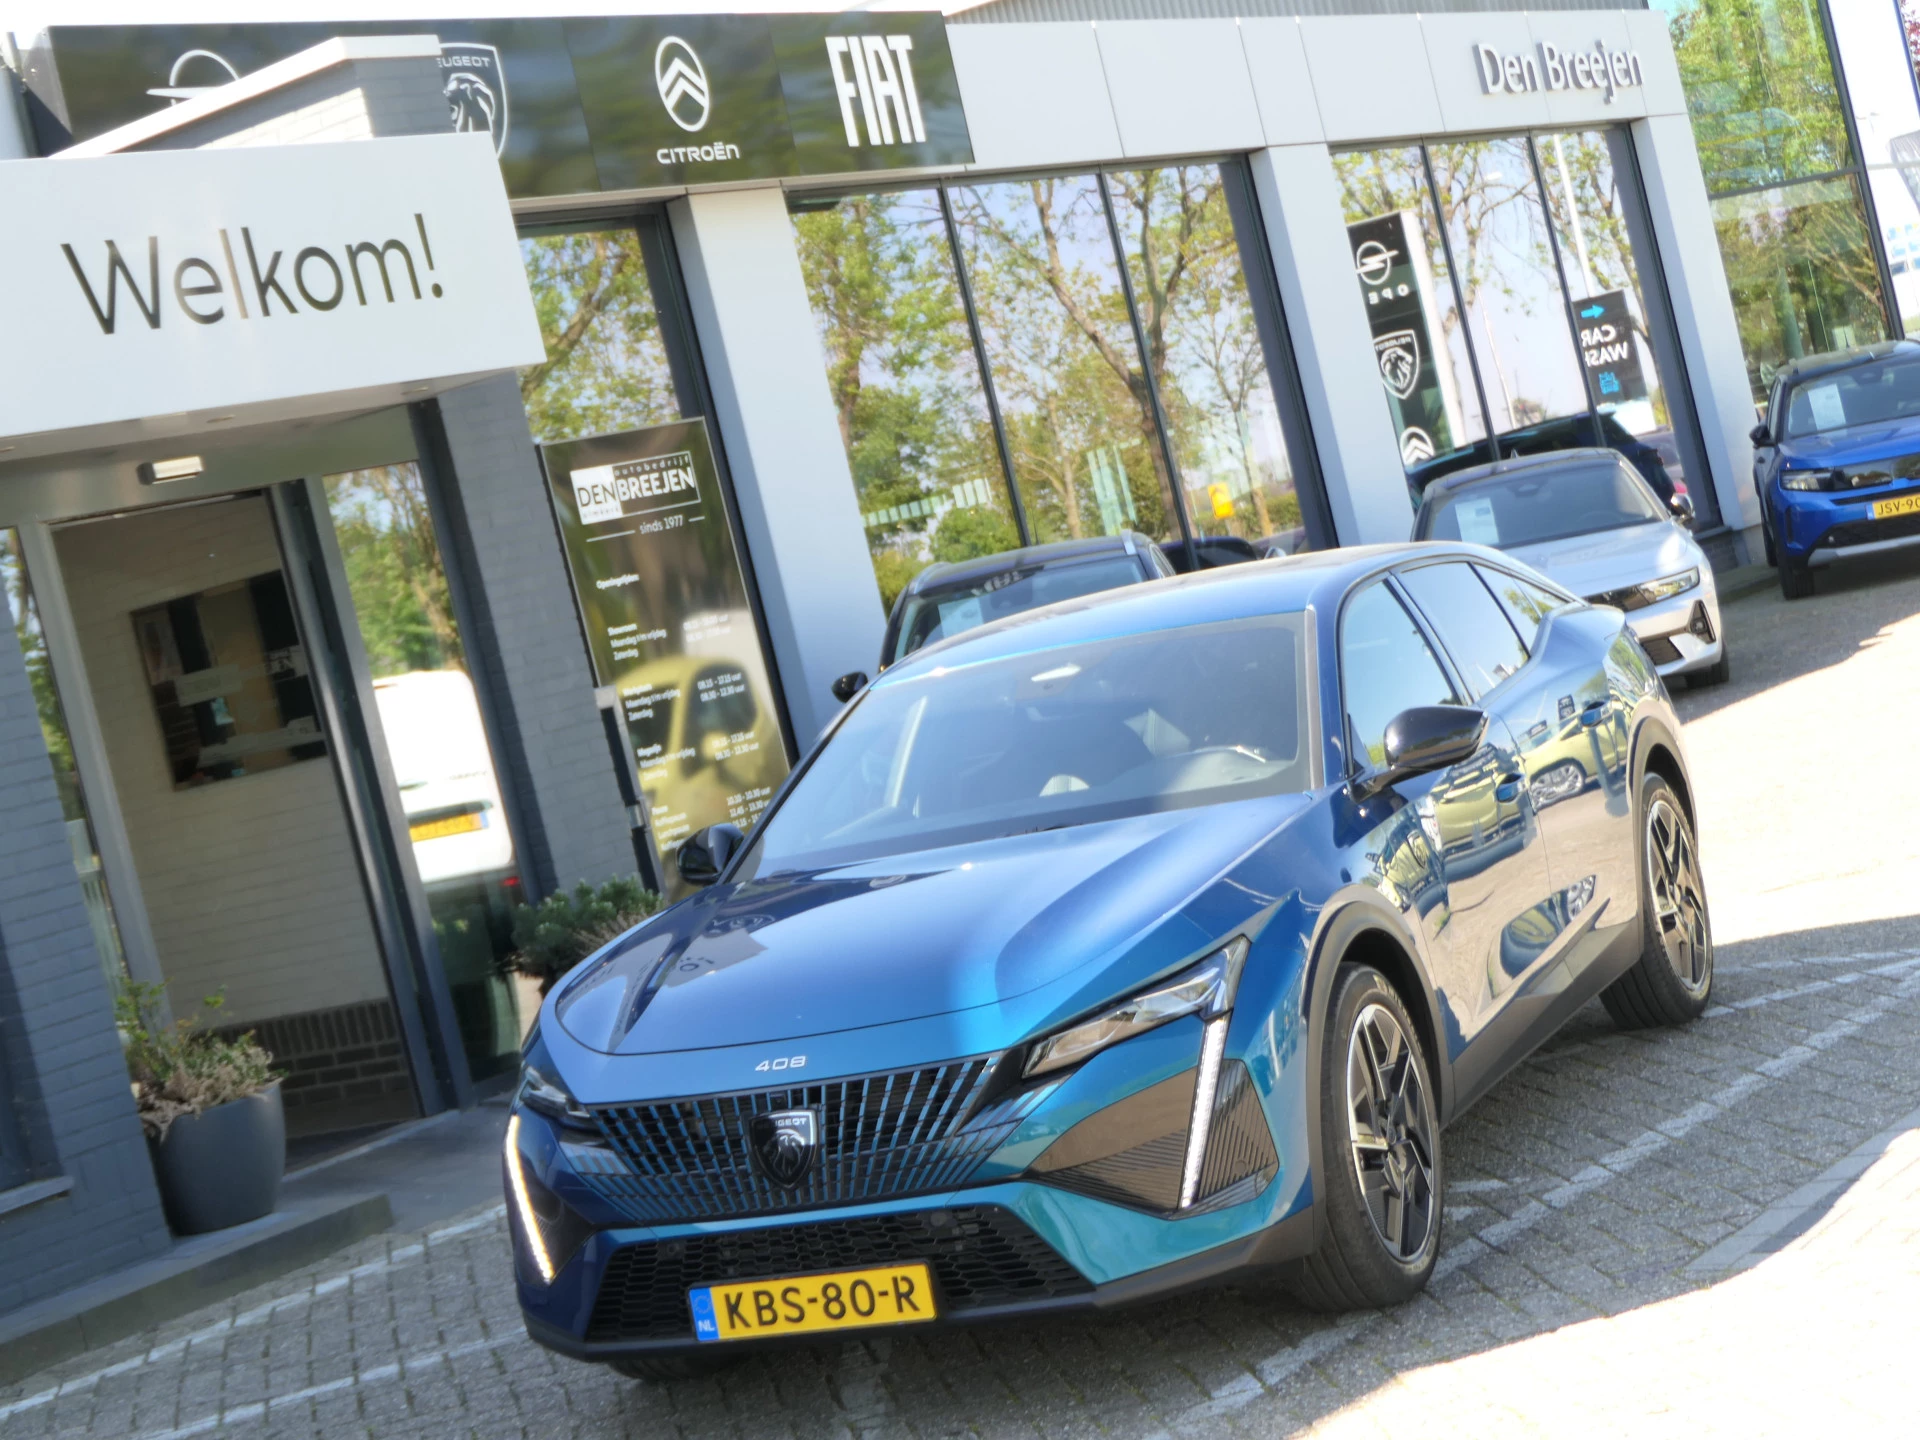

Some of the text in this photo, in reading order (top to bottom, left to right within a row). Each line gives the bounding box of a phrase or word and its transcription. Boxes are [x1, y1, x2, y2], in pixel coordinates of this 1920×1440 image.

[824, 34, 927, 147] FIAT
[1472, 38, 1645, 105] Den Breejen
[60, 213, 444, 335] Welkom!
[614, 455, 690, 477] autobedrijf
[577, 467, 696, 507] DEN BREEJEN
[639, 514, 684, 535] sinds 1977
[755, 1055, 807, 1072] 408
[724, 1275, 921, 1330] KBS-80-R
[698, 1319, 715, 1332] NL
